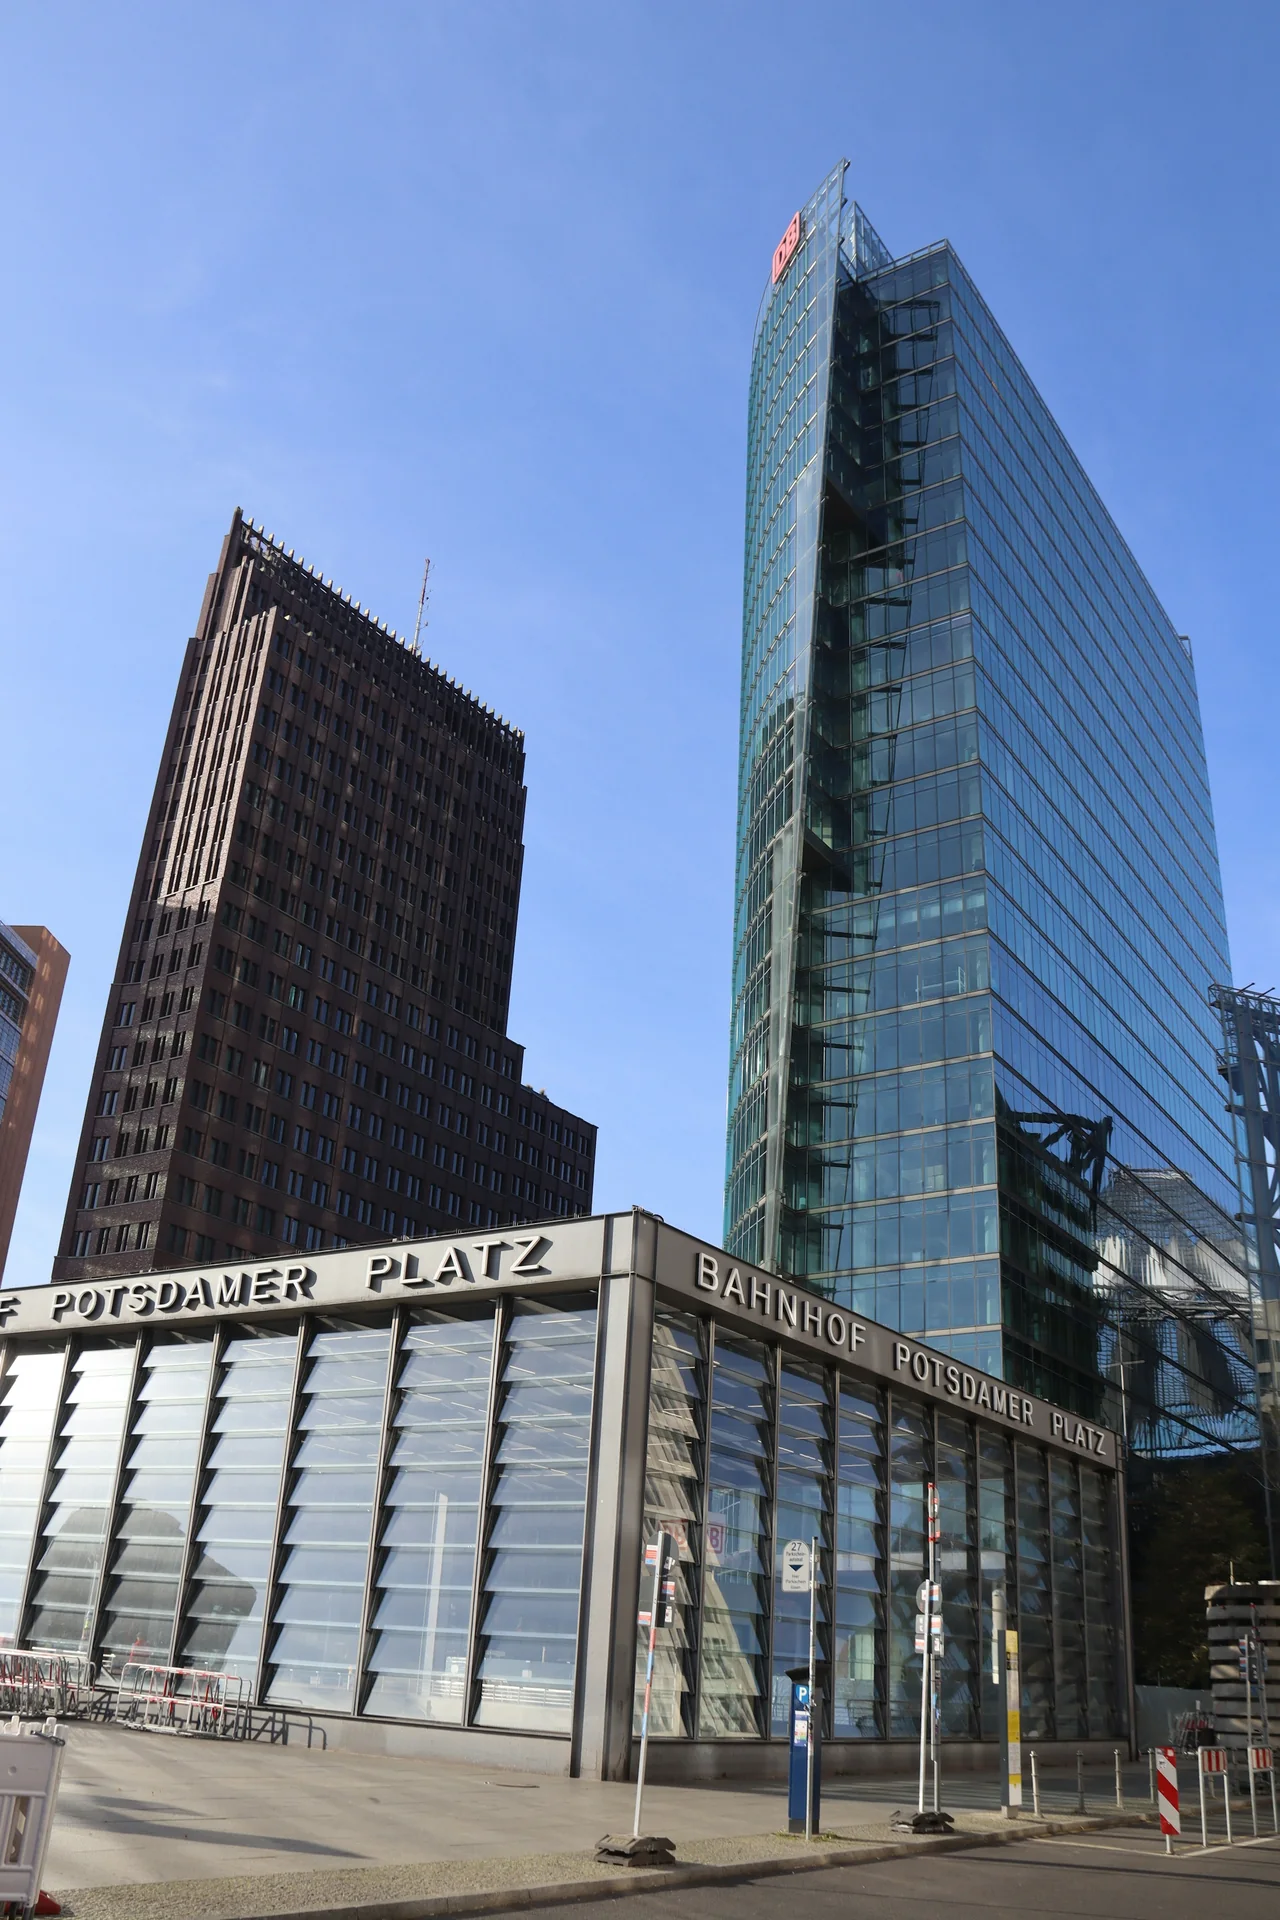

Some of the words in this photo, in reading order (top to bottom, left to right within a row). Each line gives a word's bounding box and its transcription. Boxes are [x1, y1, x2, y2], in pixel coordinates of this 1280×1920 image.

[774, 221, 797, 278] DB
[50, 1264, 309, 1321] POTSDAMER
[364, 1235, 545, 1288] PLATZ
[695, 1252, 867, 1352] BAHNHOF
[893, 1342, 1035, 1426] POTSDAMER
[1051, 1411, 1108, 1456] PLATZ
[791, 1542, 802, 1551] 27
[799, 1686, 808, 1701] P
